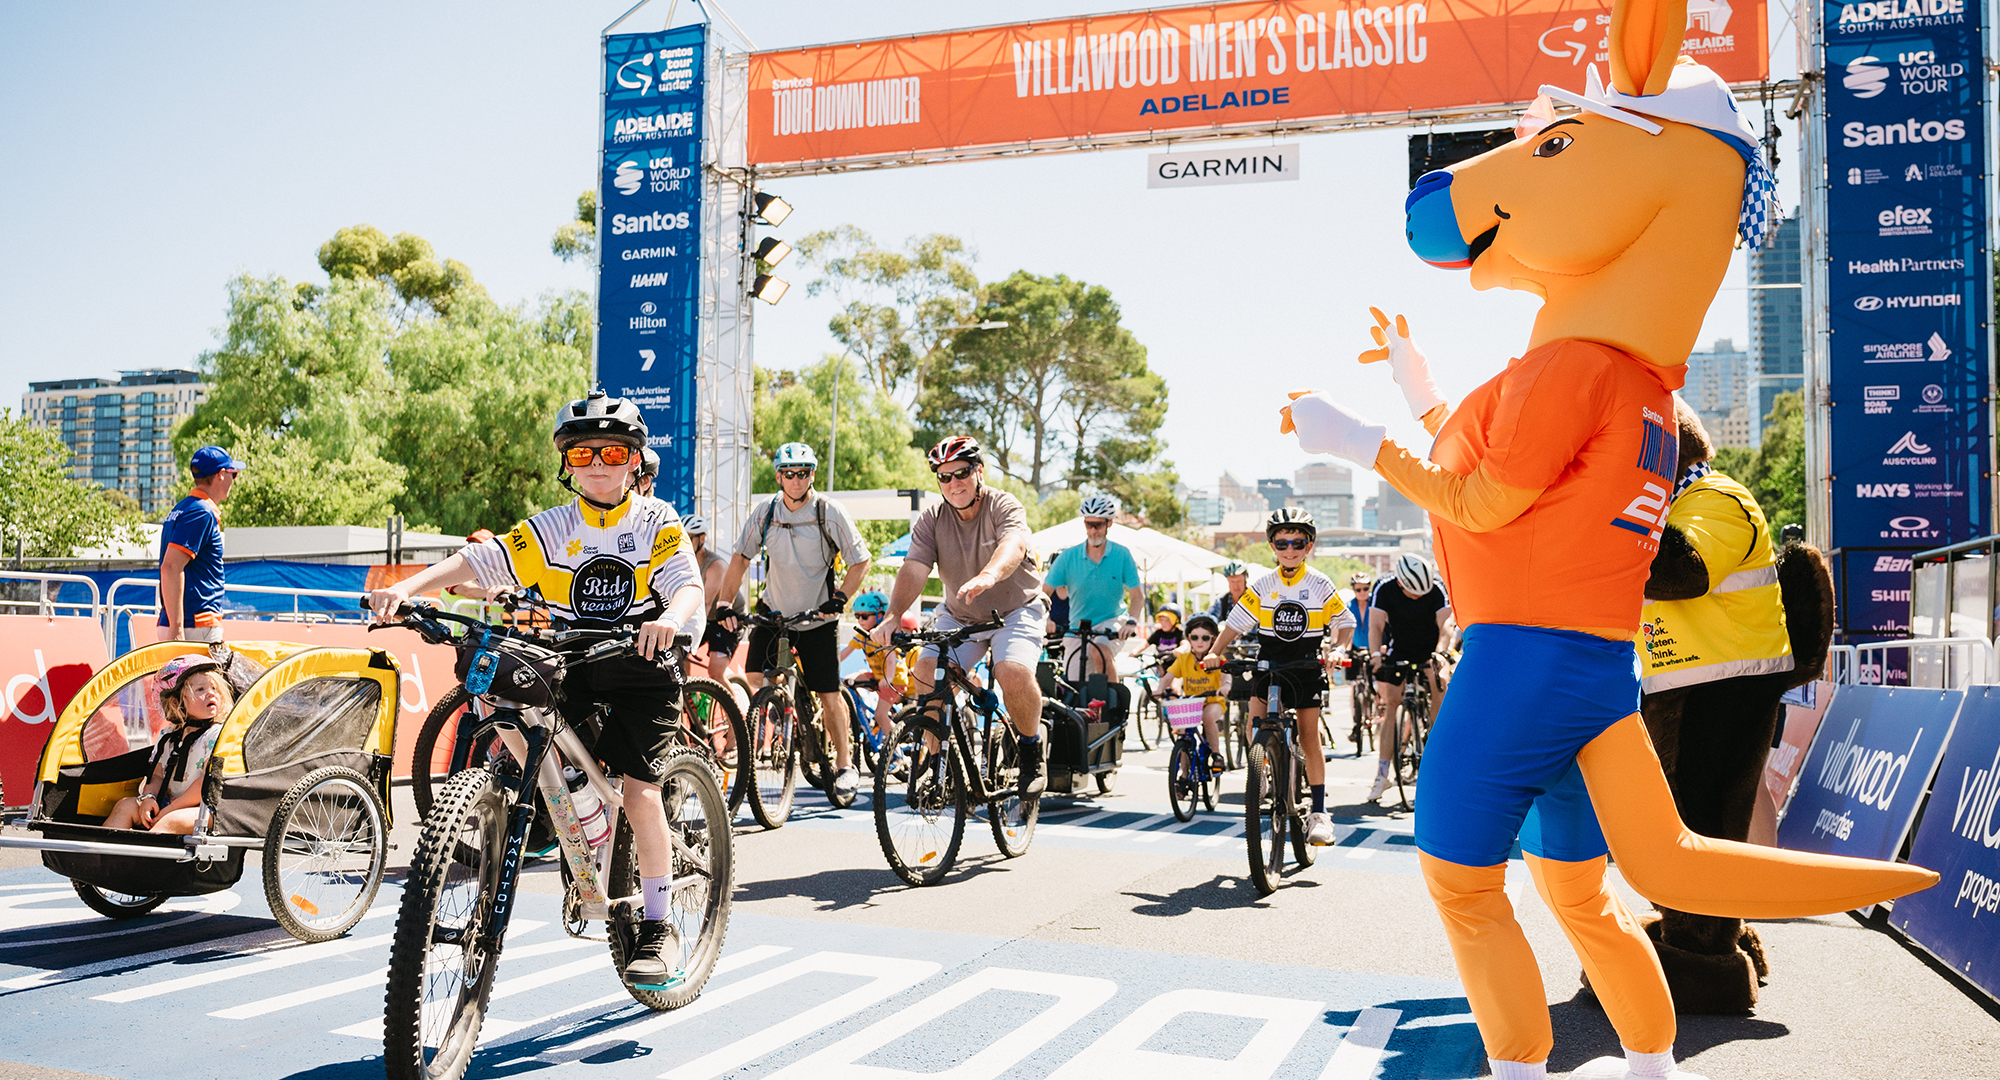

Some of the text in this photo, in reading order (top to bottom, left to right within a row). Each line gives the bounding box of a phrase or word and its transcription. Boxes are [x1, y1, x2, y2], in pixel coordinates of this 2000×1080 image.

[1839, 0, 1964, 24] ADELAIDE
[1839, 14, 1965, 35] SOUTH AUSTRALIA
[1013, 4, 1427, 98] VILLAWOOD MEN'S CLASSIC
[1681, 35, 1734, 51] DELAIDE
[660, 48, 693, 59] Santos
[1899, 51, 1935, 66] UCI
[667, 58, 693, 69] tour
[661, 69, 692, 81] down
[1900, 63, 1964, 81] WORLD
[659, 80, 692, 92] under
[772, 76, 813, 90] Santos
[1901, 79, 1948, 95] TOUR
[772, 77, 920, 136] TOUR DOWN UNDER
[1139, 87, 1290, 116] ADELAIDE
[614, 112, 693, 135] ADELAIDE
[614, 128, 693, 144] SOUTH AUSTRALIA
[1843, 118, 1966, 148] Santos
[650, 157, 673, 170] UCI
[650, 168, 691, 181] WORLD
[650, 180, 680, 193] TOUR
[612, 211, 690, 235] Santos
[1879, 205, 1932, 226] efex
[1849, 258, 1965, 274] Health Partners
[630, 272, 668, 288] HAHN
[1887, 294, 1961, 308] HYUNDAI
[630, 316, 666, 329] Hilton
[1863, 343, 1923, 353] SINGAPORE
[1876, 351, 1923, 359] AIRLINES
[622, 387, 670, 396] The Advertiser
[1643, 406, 1664, 426] Santos
[1883, 457, 1937, 466] AUSCYCLING
[1857, 484, 1910, 498] HAYS
[1880, 530, 1939, 538] OAKLEY
[583, 575, 629, 596] Ride
[581, 597, 625, 612] reason
[1276, 611, 1303, 622] Ride
[1818, 719, 1923, 811] villawood
[1812, 808, 1854, 842] properties
[495, 836, 522, 914] MANITOU
